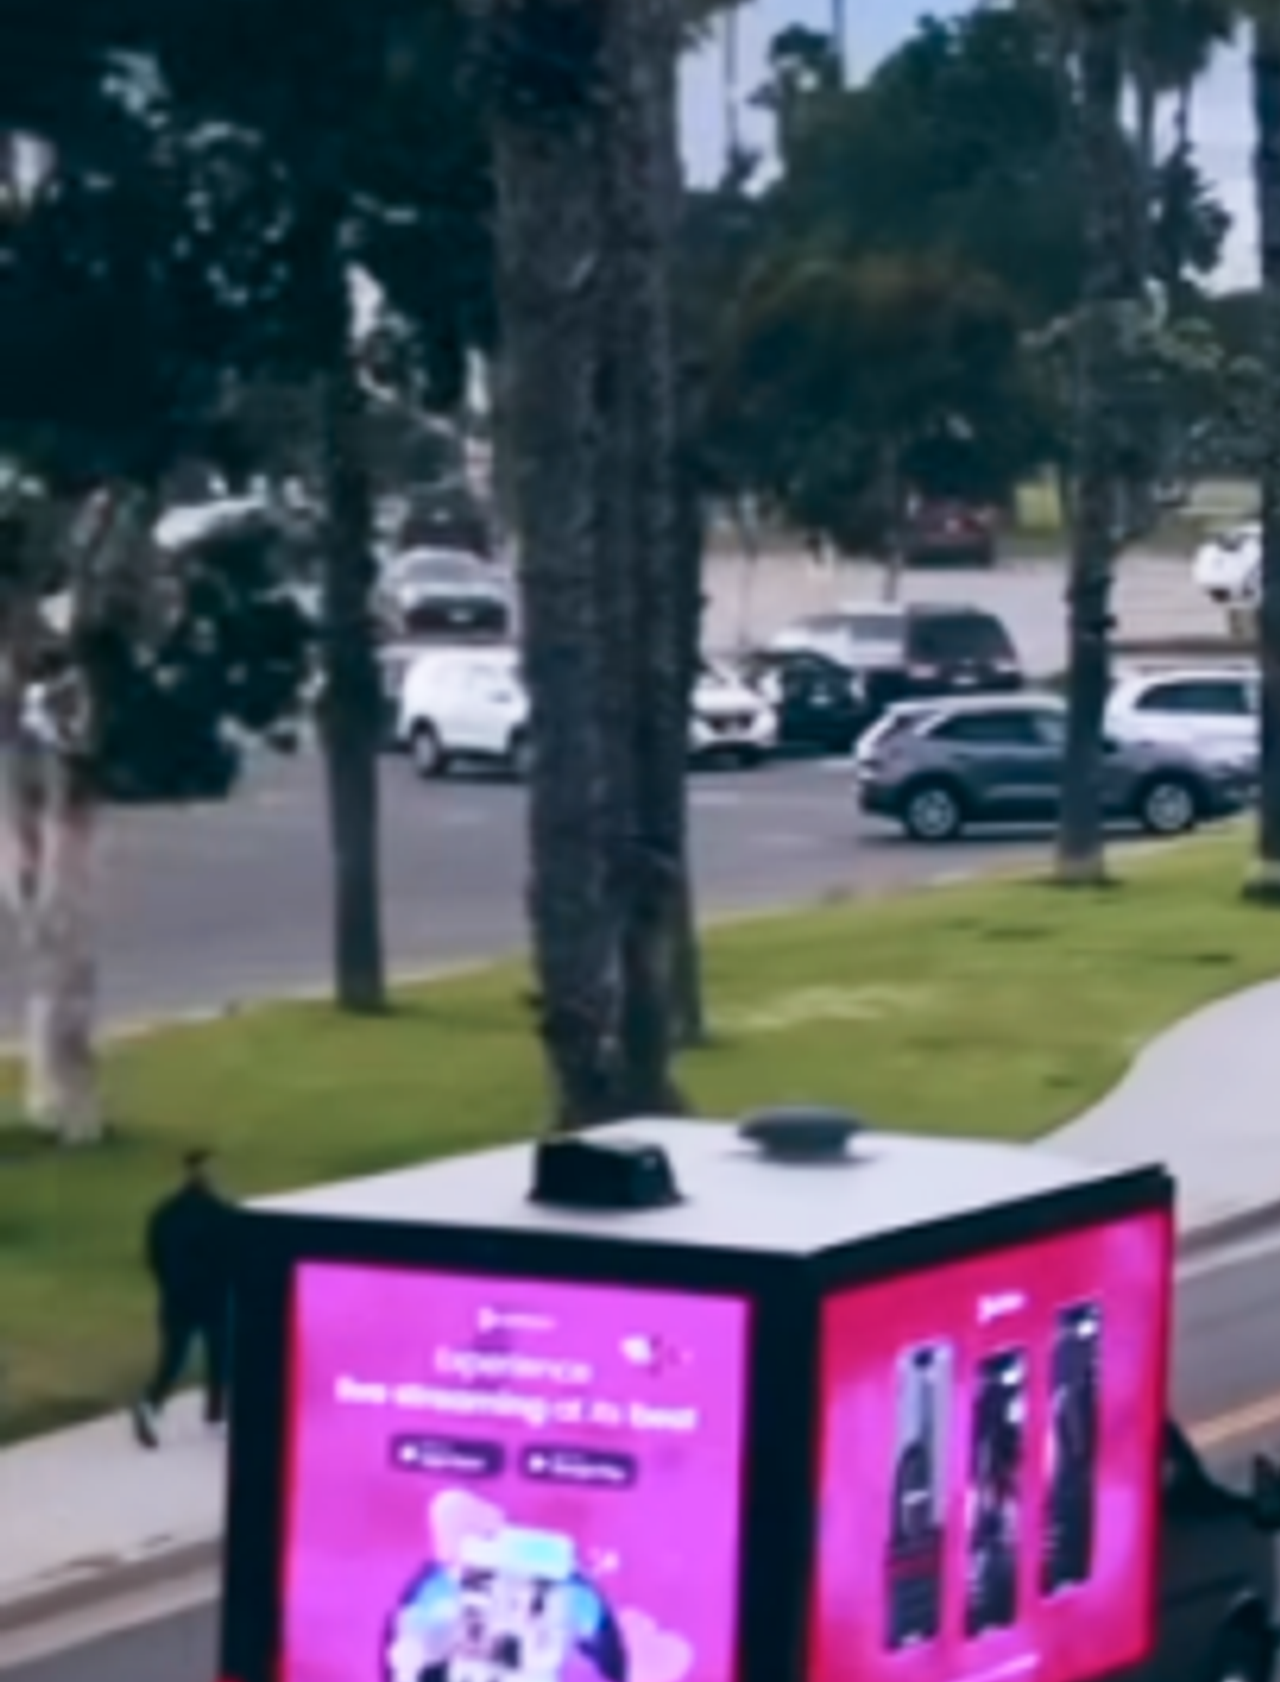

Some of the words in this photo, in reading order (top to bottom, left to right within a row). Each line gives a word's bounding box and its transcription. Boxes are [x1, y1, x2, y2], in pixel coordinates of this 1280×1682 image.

[434, 1347, 593, 1384] Experience
[394, 1384, 551, 1427] streaming
[553, 1400, 582, 1423] at
[629, 1401, 699, 1430] best
